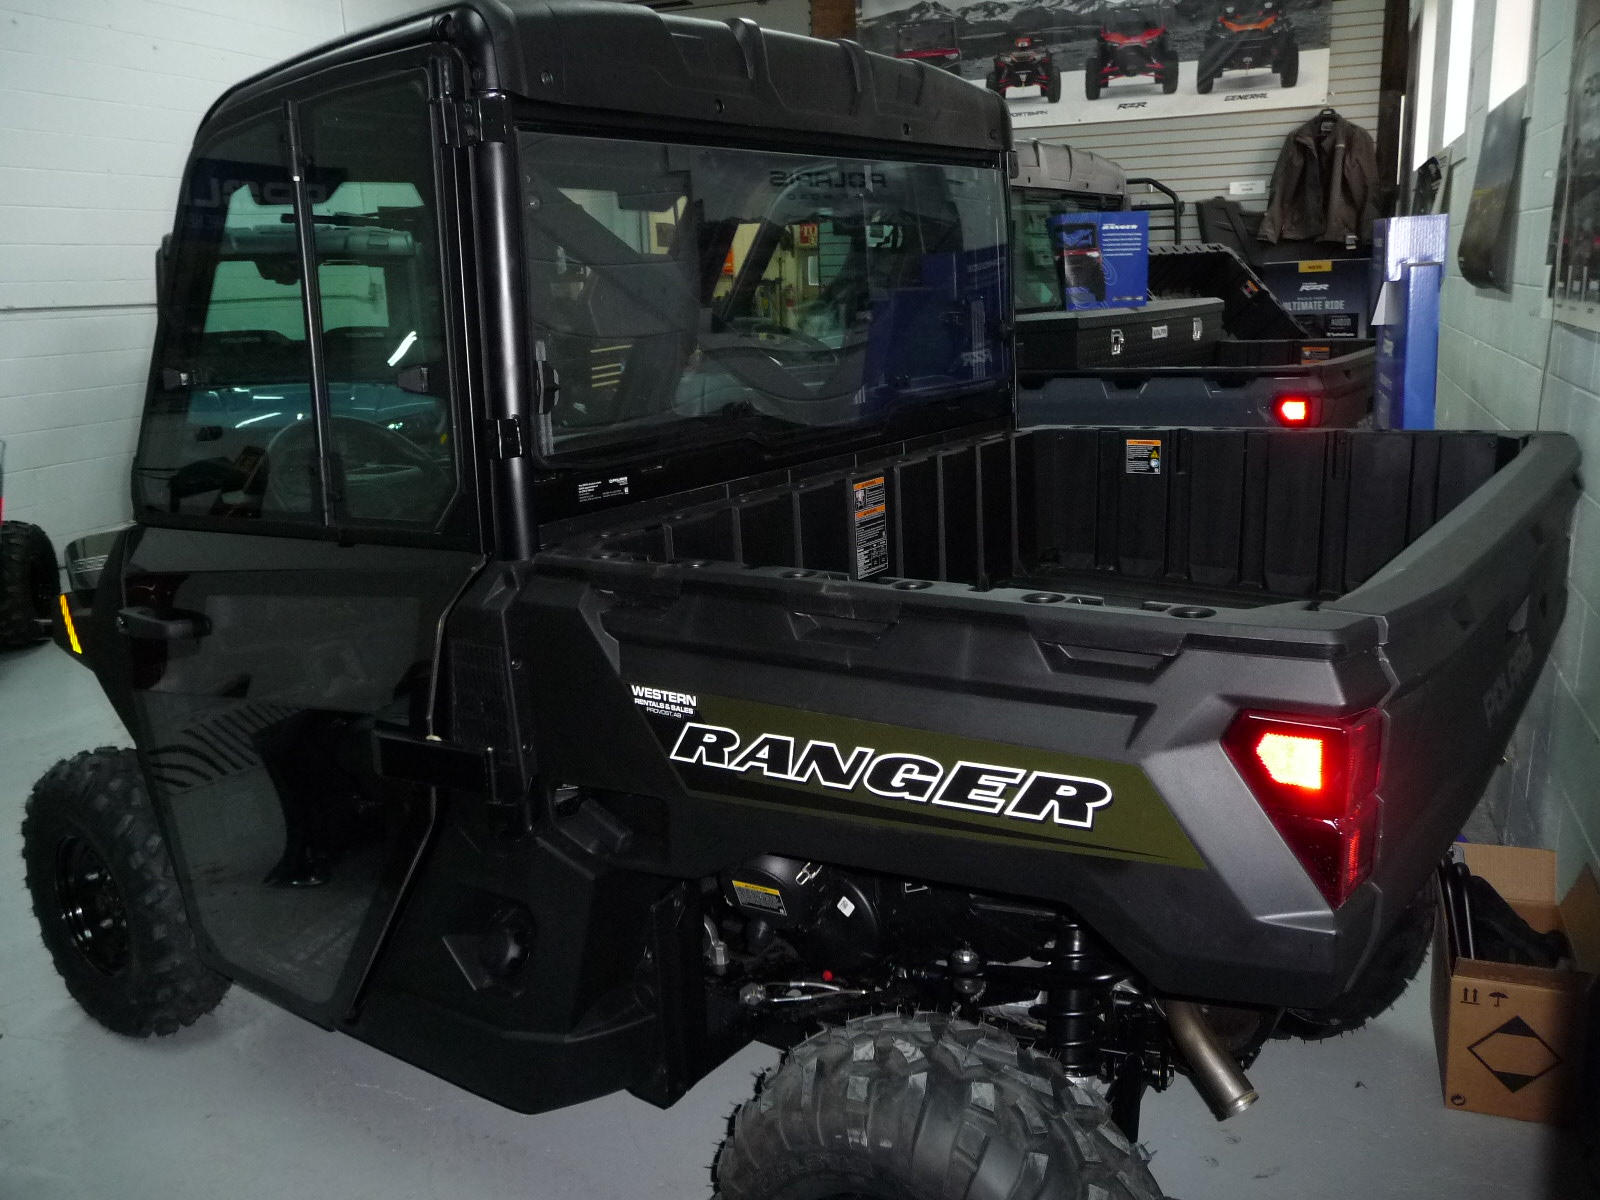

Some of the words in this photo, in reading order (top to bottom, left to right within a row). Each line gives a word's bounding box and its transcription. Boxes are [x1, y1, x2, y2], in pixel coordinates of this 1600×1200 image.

[1224, 92, 1269, 102] GENERAL
[1116, 101, 1148, 110] RZR
[1009, 109, 1049, 118] ORTSMAN
[630, 684, 697, 707] WESTERN
[633, 697, 666, 709] RENTALS
[665, 703, 671, 711] &
[670, 704, 695, 715] SALES
[669, 721, 1113, 829] RANGER
